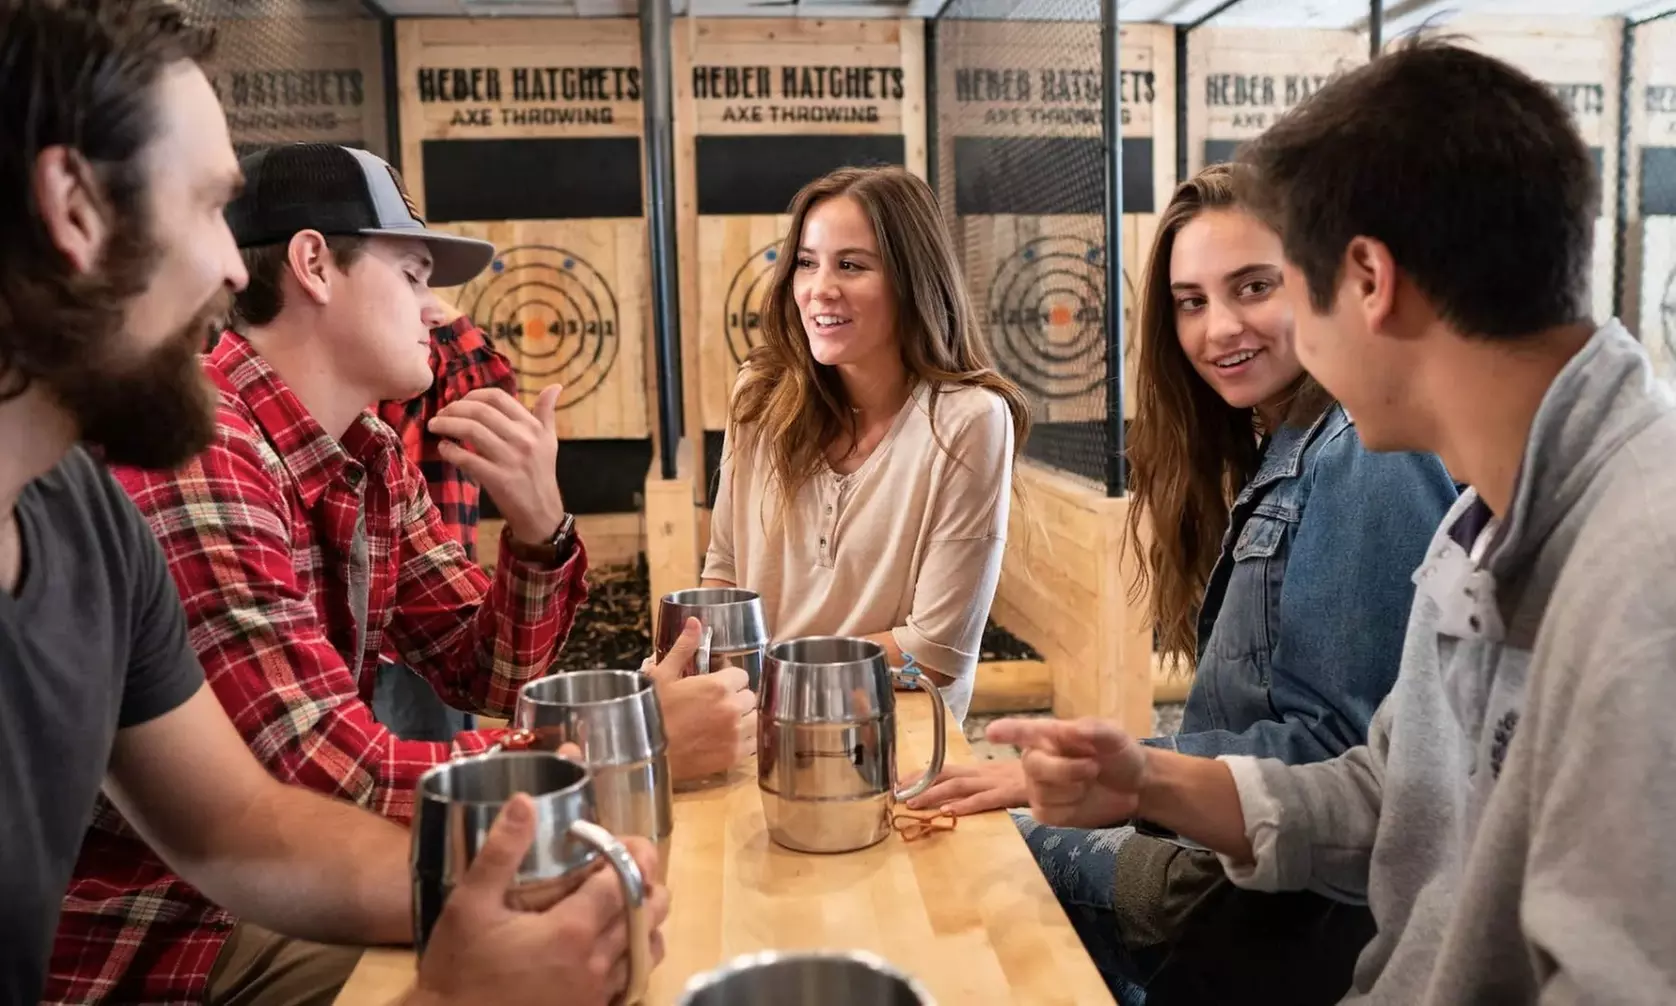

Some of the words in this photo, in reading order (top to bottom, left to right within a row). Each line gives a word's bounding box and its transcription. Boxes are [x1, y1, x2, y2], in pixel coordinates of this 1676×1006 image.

[418, 67, 501, 103] HEBER
[512, 66, 641, 102] HATCHETS
[692, 66, 770, 99] HEBER
[781, 66, 904, 99] HATCHETS
[1206, 74, 1274, 106] HEBER
[450, 109, 492, 126] AXE
[500, 107, 614, 125] THROWING
[722, 106, 763, 123] AXE
[769, 105, 879, 123] THROWING
[731, 312, 738, 328] 1
